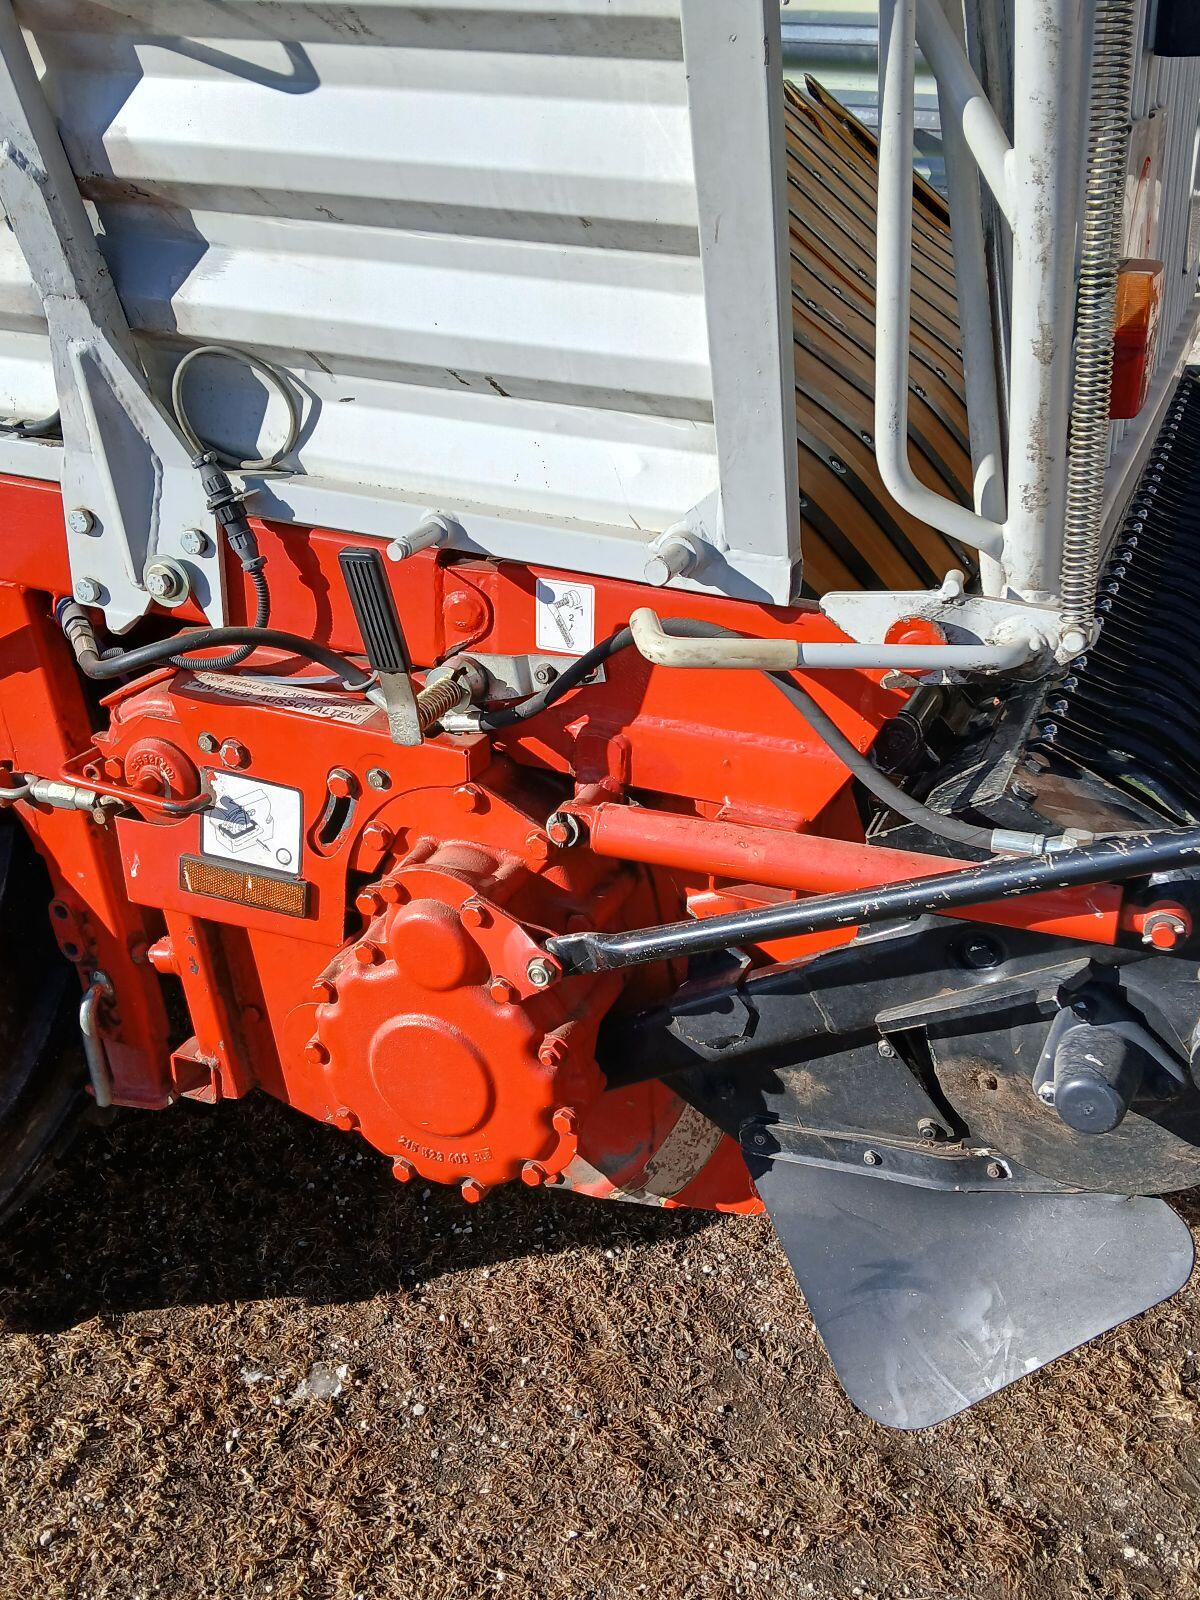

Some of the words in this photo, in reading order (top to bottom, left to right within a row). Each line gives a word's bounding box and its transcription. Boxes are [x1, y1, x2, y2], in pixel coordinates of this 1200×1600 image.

[568, 613, 576, 622] 2
[206, 674, 226, 683] VOR
[227, 679, 260, 690] ABBAU
[260, 686, 282, 695] DES
[193, 682, 254, 699] ANTRIEB
[255, 694, 363, 721] AUSSCHALTEN!
